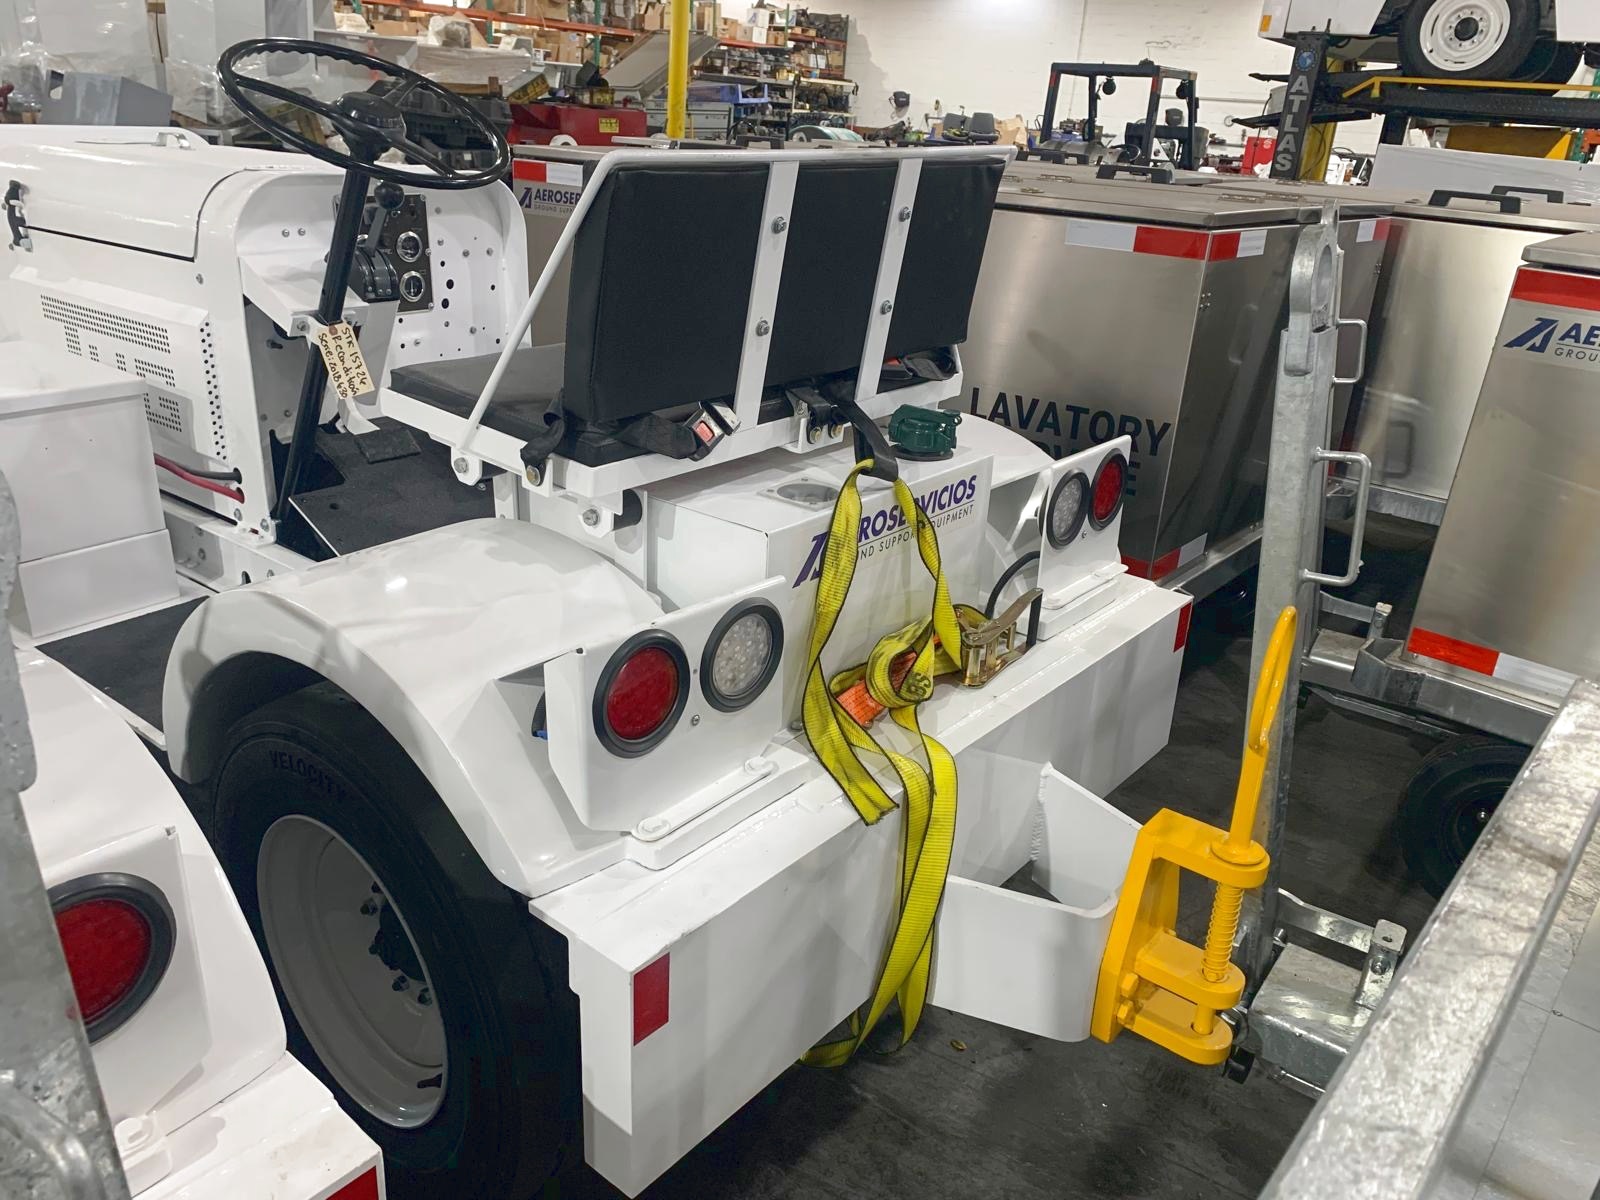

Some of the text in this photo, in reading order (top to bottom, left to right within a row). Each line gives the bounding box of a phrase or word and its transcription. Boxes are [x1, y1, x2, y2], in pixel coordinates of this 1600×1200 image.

[1275, 75, 1310, 171] ATLAS
[342, 327, 355, 348] STK
[1554, 347, 1600, 362] GROU
[970, 387, 1171, 457] LAVATORY
[857, 475, 977, 543] ROSEVICIOS
[879, 504, 975, 552] SUPPO UIPMENT
